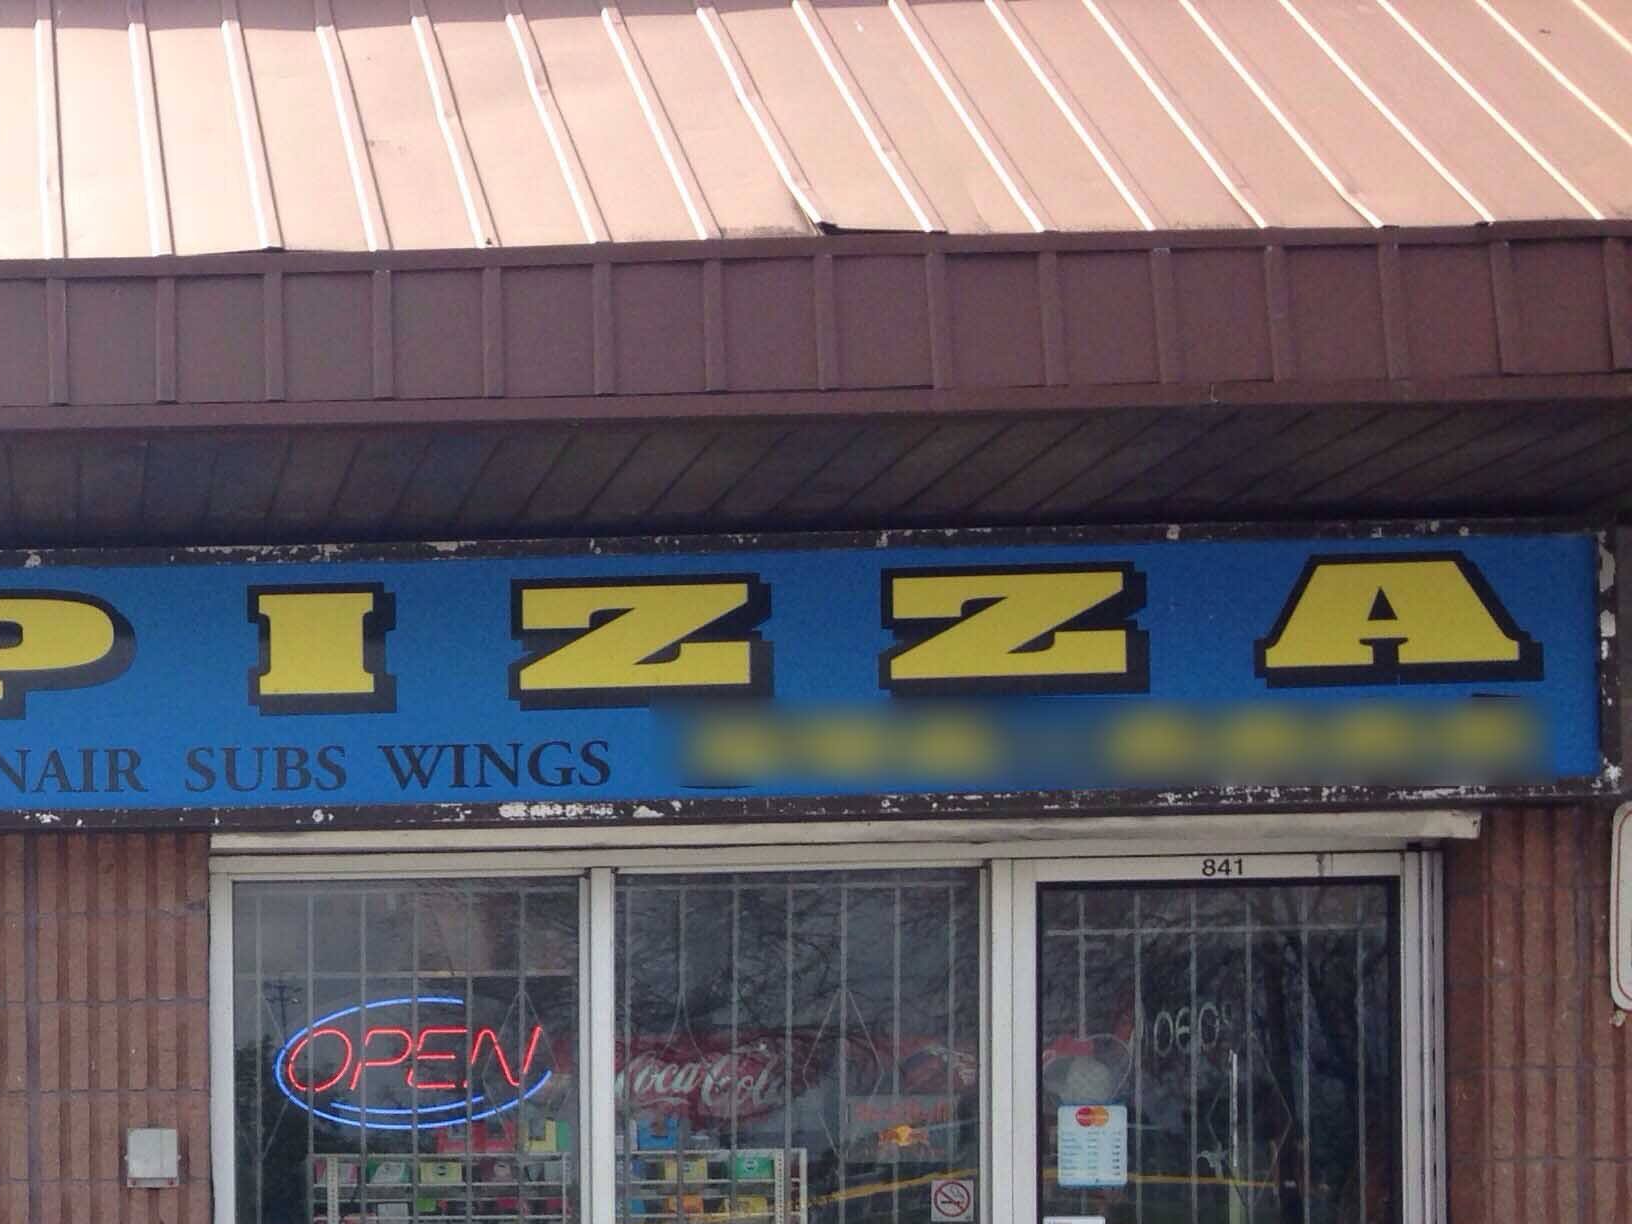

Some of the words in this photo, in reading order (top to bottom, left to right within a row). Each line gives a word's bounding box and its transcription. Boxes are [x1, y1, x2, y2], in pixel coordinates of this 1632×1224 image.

[184, 743, 348, 794] SUBS
[377, 739, 612, 790] WINGS
[1201, 857, 1245, 877] 841
[287, 1024, 543, 1092] OPEN
